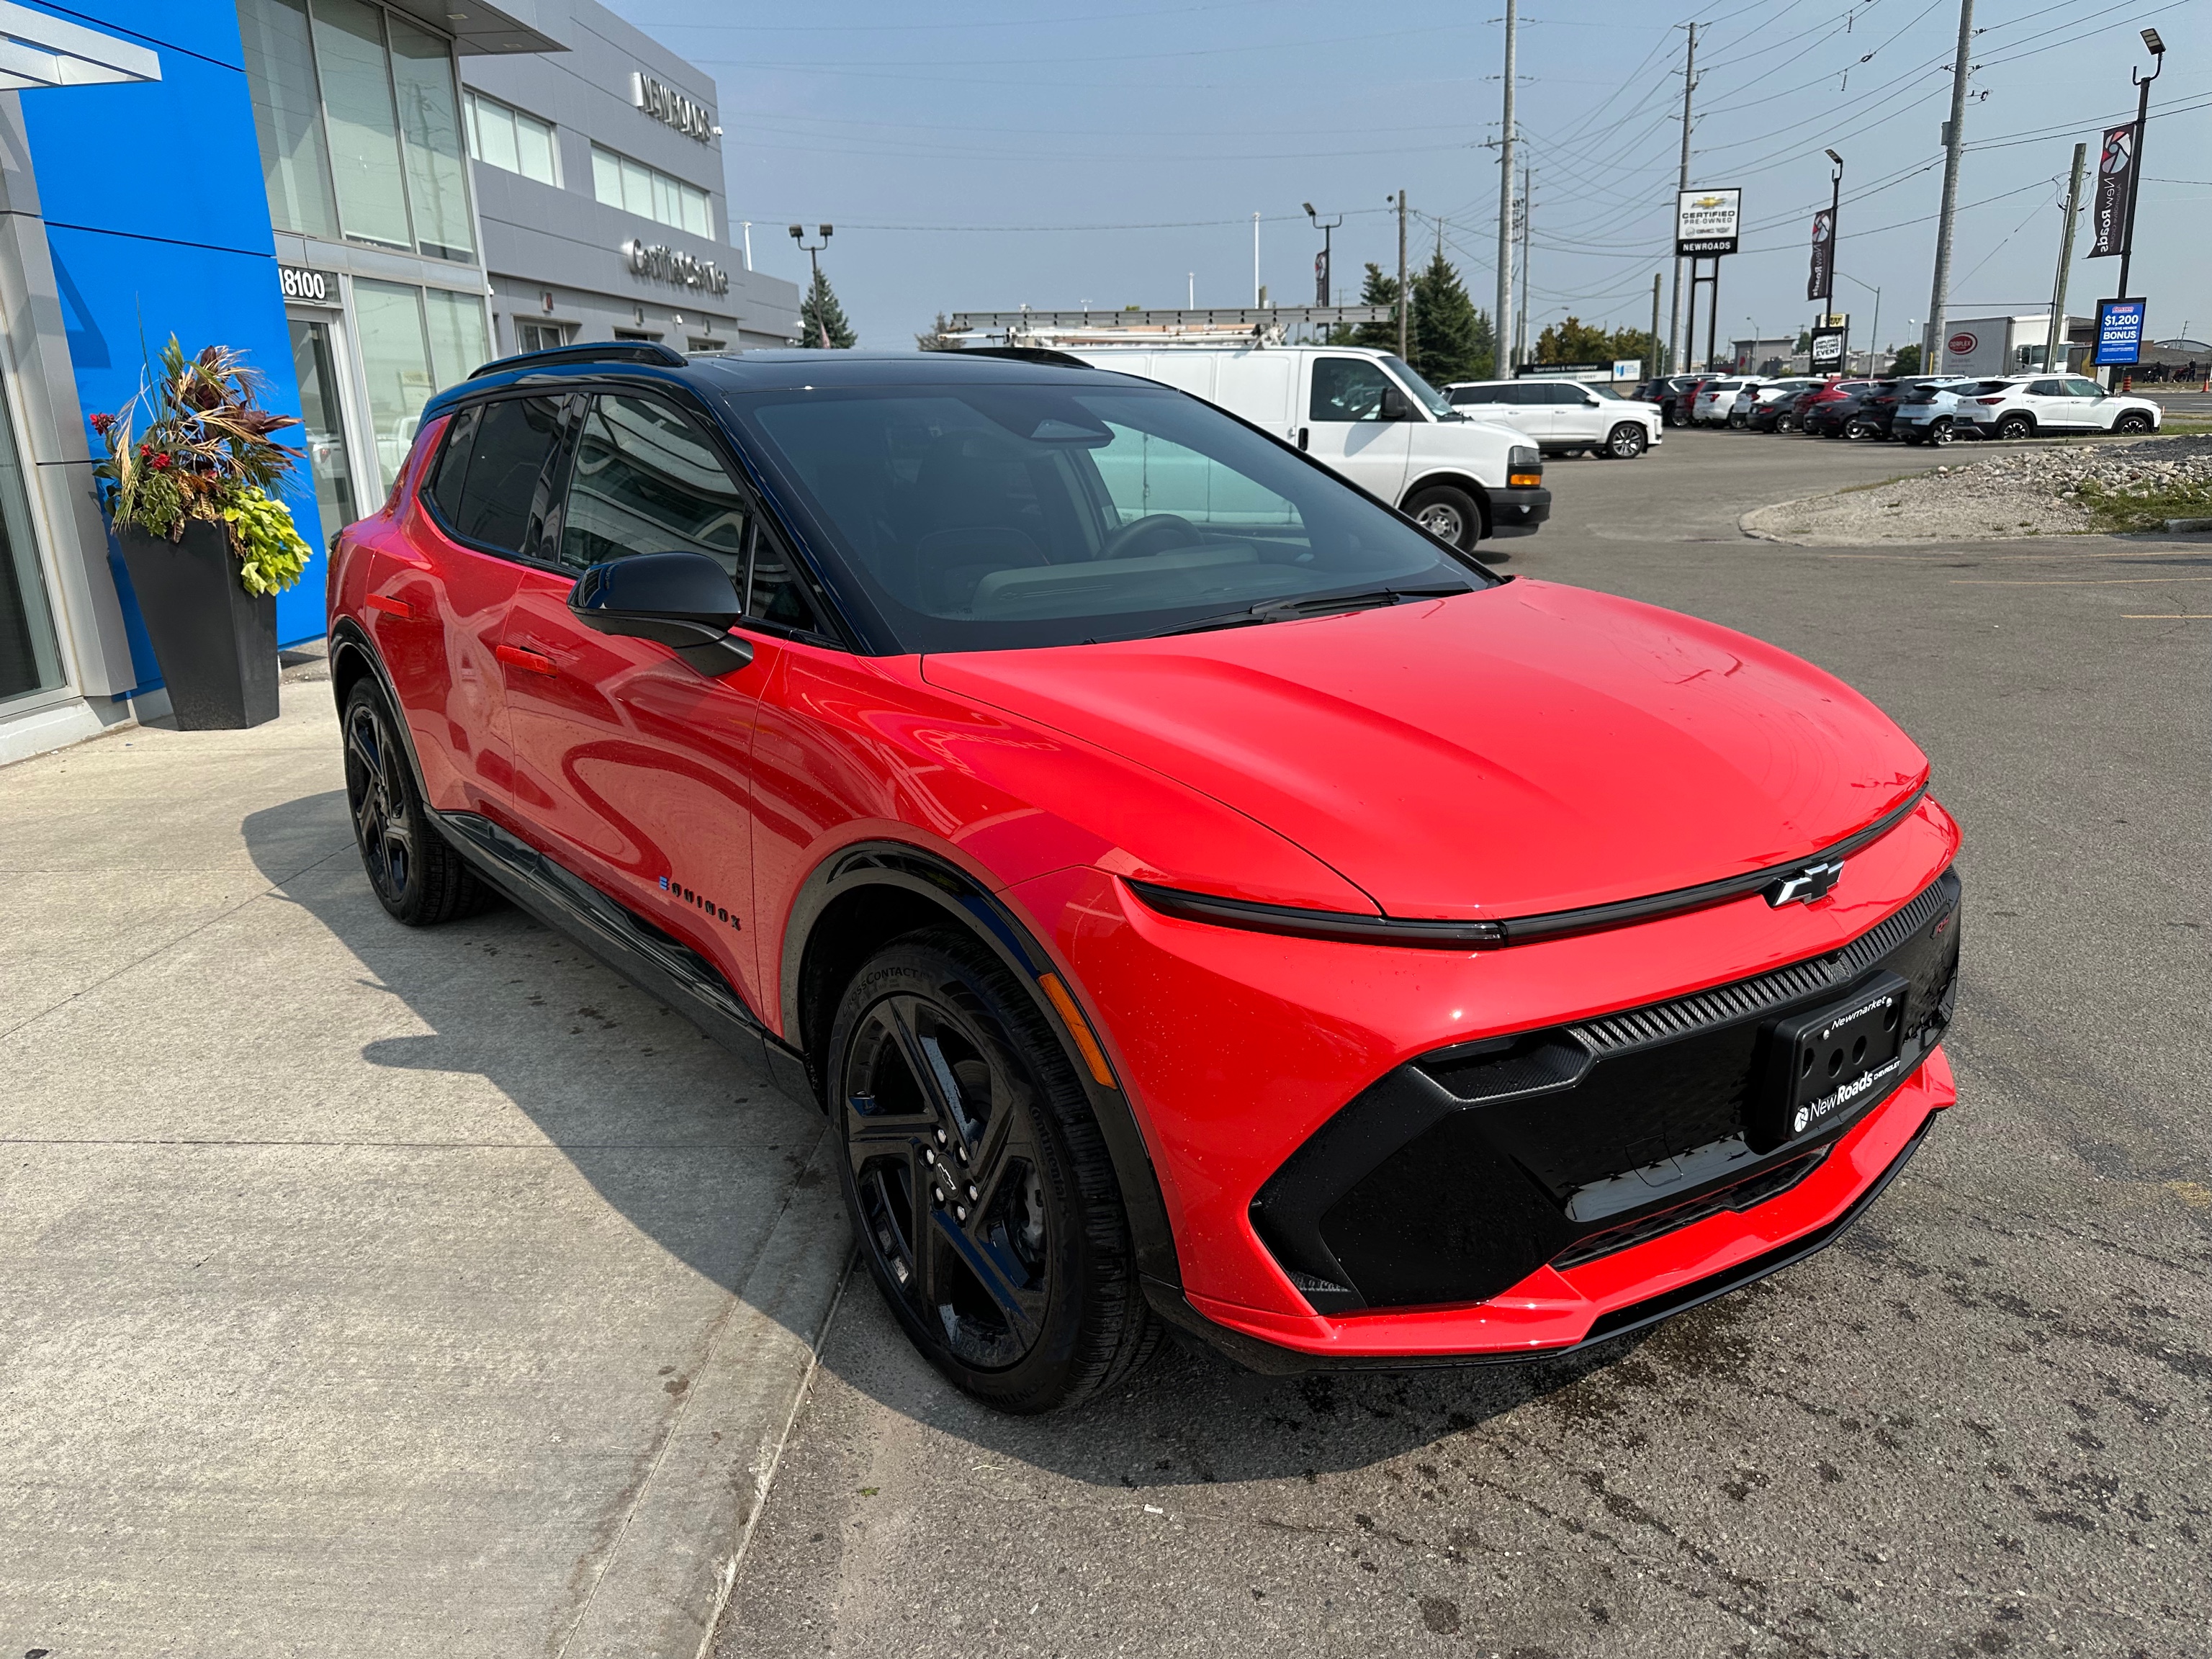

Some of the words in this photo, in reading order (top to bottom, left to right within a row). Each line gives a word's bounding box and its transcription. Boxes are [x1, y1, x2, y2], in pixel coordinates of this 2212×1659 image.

[1681, 210, 1735, 219] CERTIFIED
[1683, 242, 1731, 251] NEWROADS
[278, 268, 325, 300] 18100
[2104, 315, 2139, 326] $1,200
[2103, 331, 2136, 340] BONUS
[1816, 348, 1839, 356] EVENT
[659, 876, 742, 932] EQUINOX
[1831, 996, 1887, 1030] Newmarket
[1809, 1071, 1873, 1122] NewRoads
[1874, 1060, 1901, 1081] CHEVROLET
